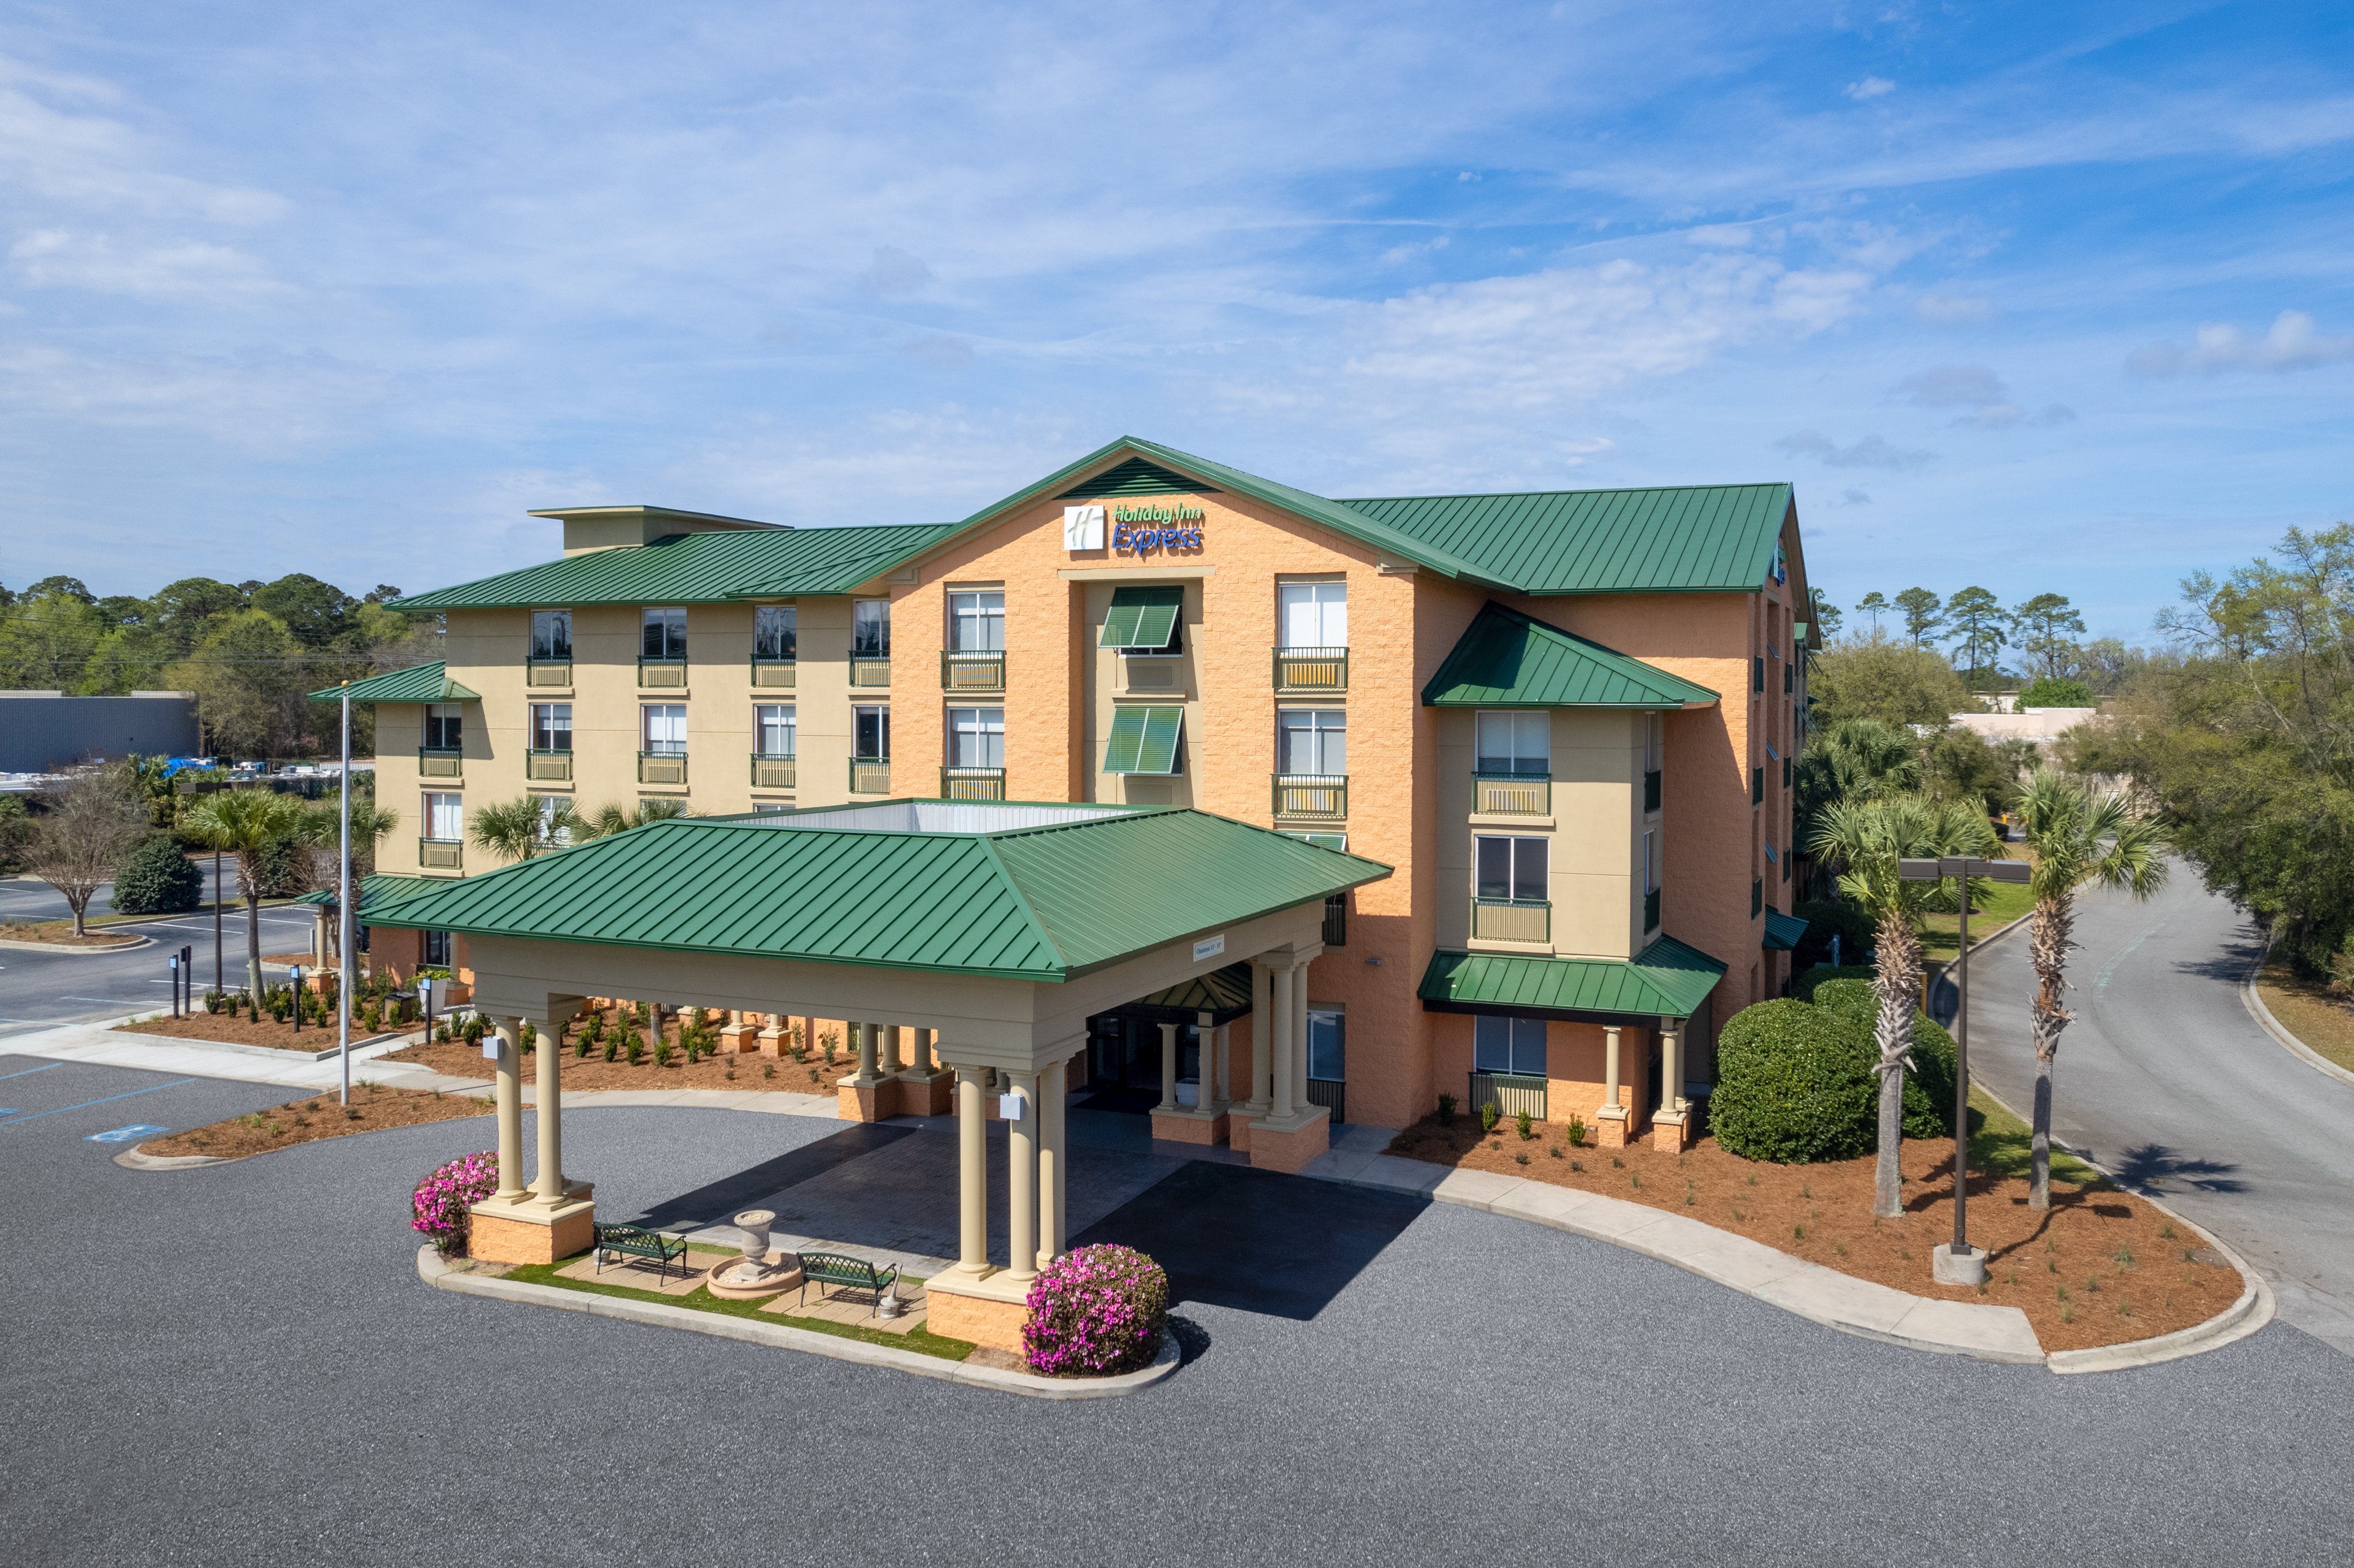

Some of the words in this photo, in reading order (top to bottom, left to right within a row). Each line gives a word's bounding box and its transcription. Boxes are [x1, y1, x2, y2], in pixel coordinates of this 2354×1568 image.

[1113, 504, 1173, 524] Holiday
[1175, 503, 1202, 520] Inn
[1111, 524, 1202, 555] Express
